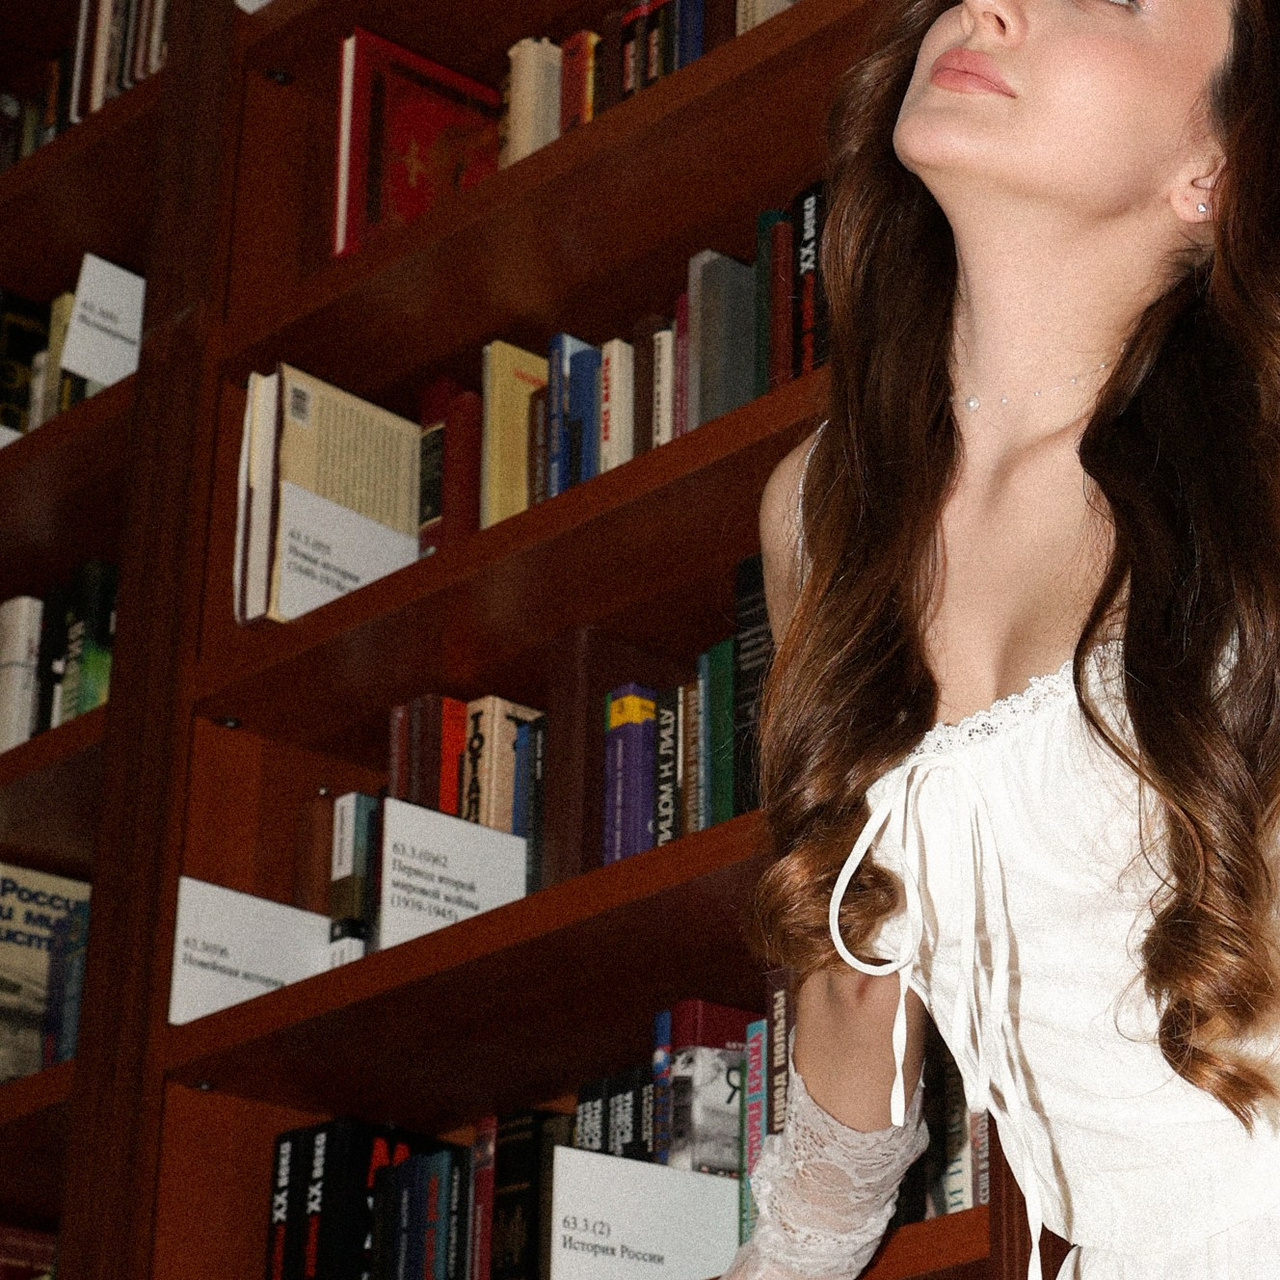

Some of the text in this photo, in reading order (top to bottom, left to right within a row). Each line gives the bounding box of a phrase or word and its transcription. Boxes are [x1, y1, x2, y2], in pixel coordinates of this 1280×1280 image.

[801, 241, 817, 274] XX
[773, 989, 786, 1067] ПОЛЬЗЫ
[748, 1033, 763, 1093] КРЫМА
[278, 1142, 291, 1187] века
[313, 1133, 326, 1178] века
[273, 1191, 287, 1221] XX
[308, 1182, 322, 1212] XX
[562, 1235, 664, 1264] История России
